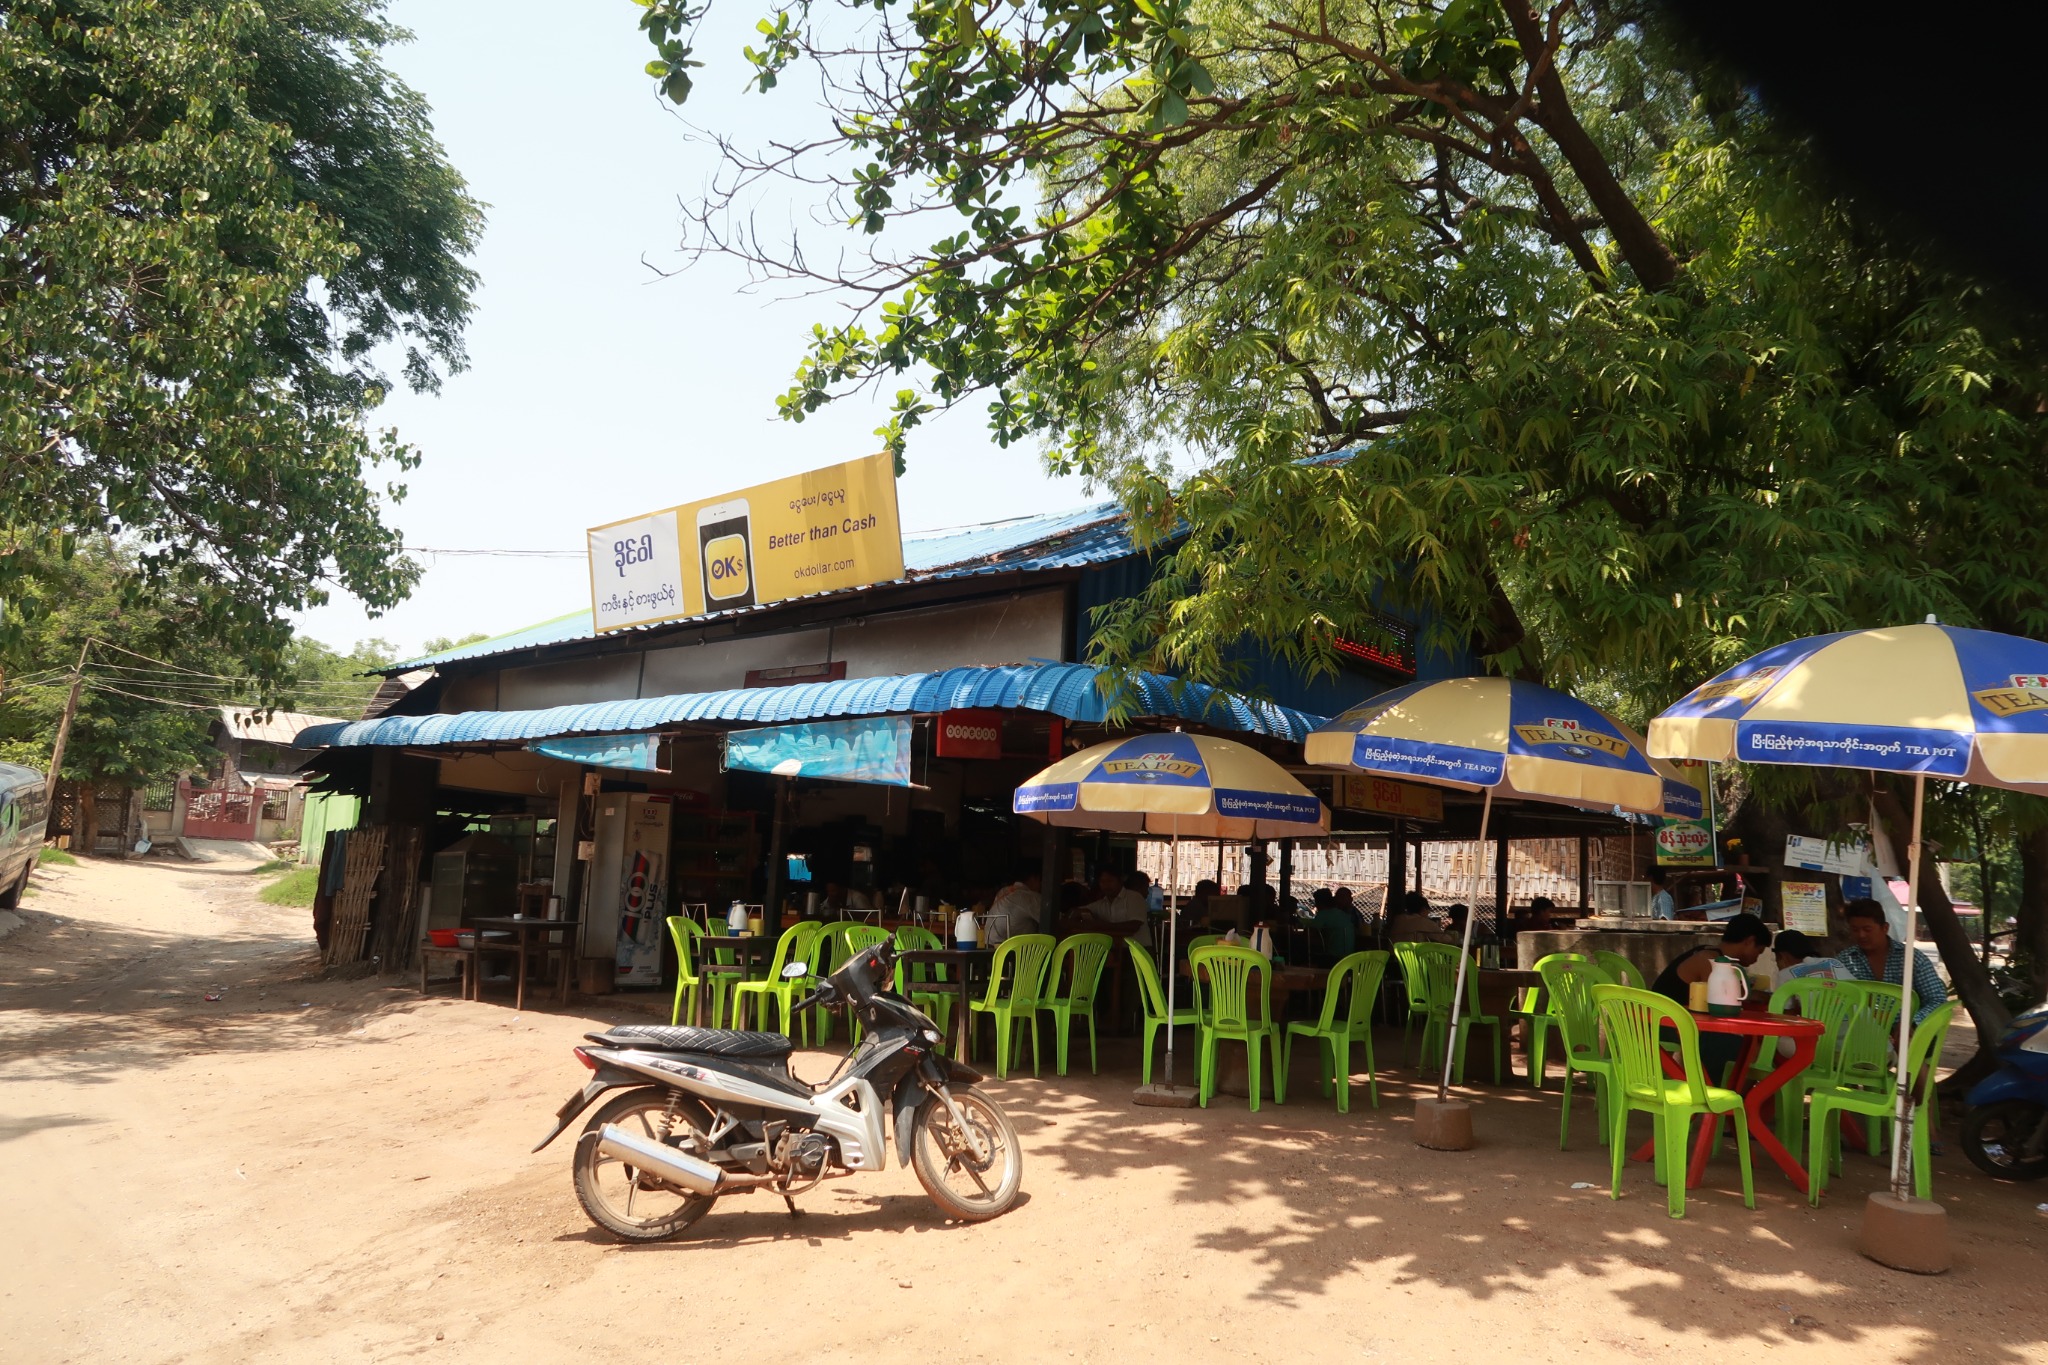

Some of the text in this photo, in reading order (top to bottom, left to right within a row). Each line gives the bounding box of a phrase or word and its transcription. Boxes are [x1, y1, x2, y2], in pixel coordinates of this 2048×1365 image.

[768, 513, 876, 550] Better than Cash
[794, 558, 855, 579] okdollar.com
[1981, 692, 2048, 710] TEA
[1547, 718, 1576, 730] F&N
[1520, 729, 1623, 752] TEA POT
[1904, 745, 1930, 756] TEA
[1932, 747, 1956, 757] POT
[1109, 761, 1196, 774] TEA POT
[1464, 762, 1479, 771] TEA
[1480, 765, 1497, 774] POT
[644, 883, 658, 920] PLUS
